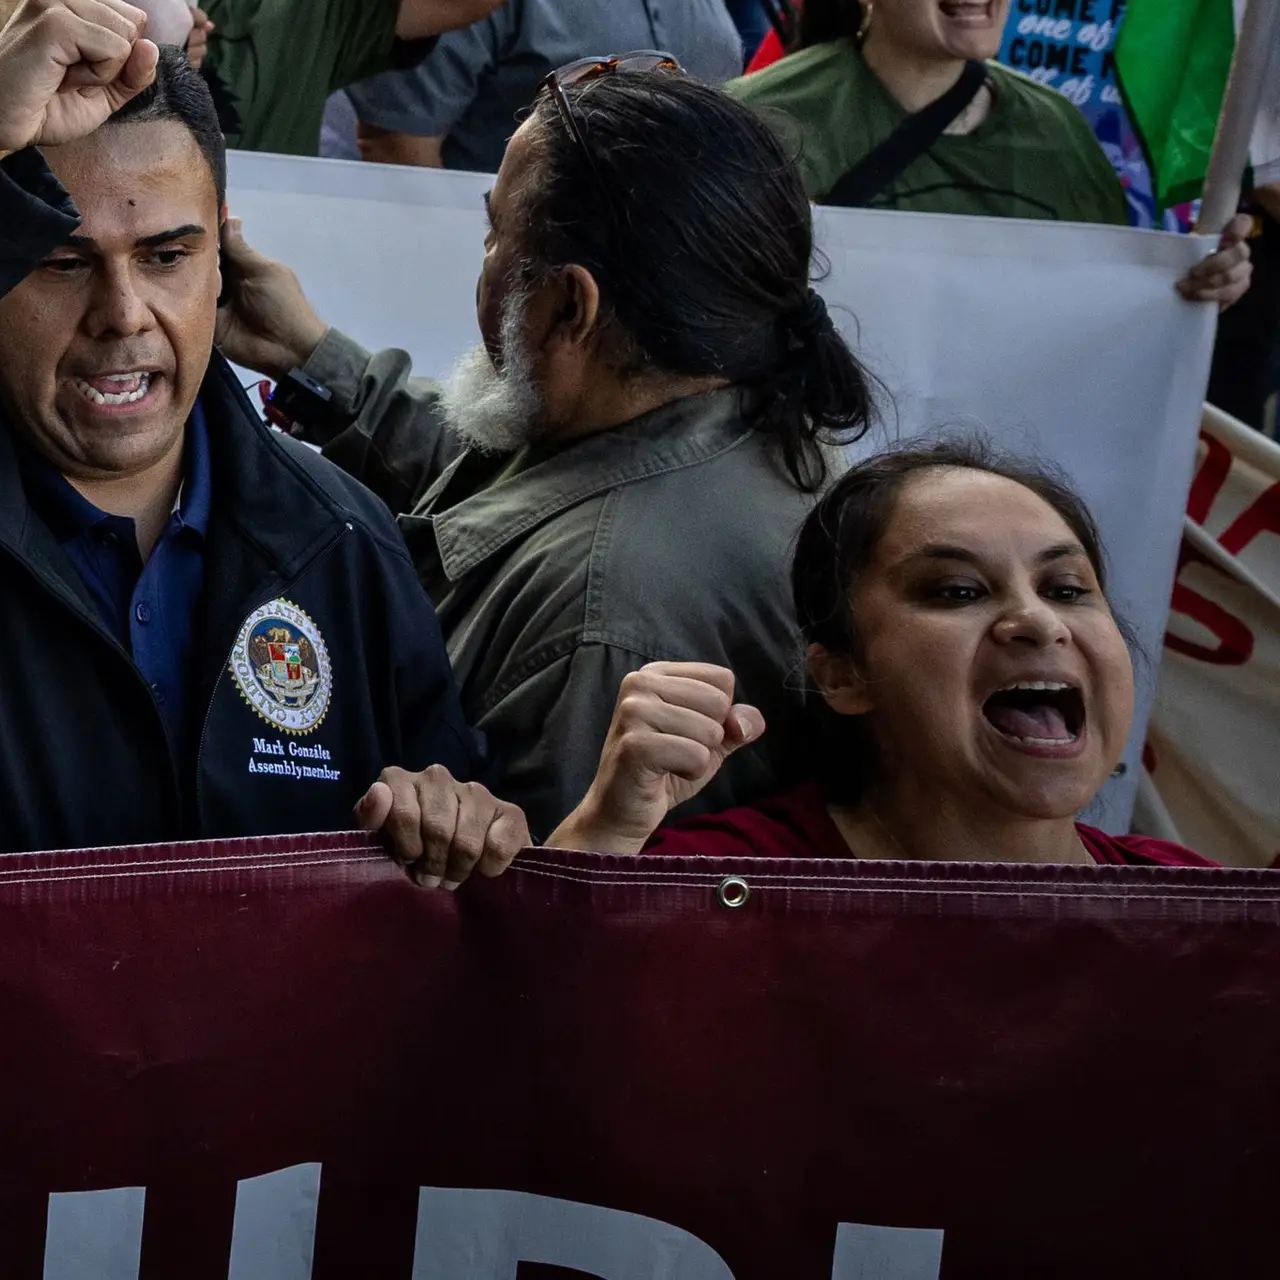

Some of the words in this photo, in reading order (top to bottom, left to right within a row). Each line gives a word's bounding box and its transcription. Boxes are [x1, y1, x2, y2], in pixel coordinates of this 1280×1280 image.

[1016, 14, 1073, 41] one
[1076, 20, 1114, 52] of
[1008, 37, 1090, 76] COME
[252, 736, 285, 756] Mark
[288, 741, 332, 761] González
[247, 756, 342, 782] Assemblymember
